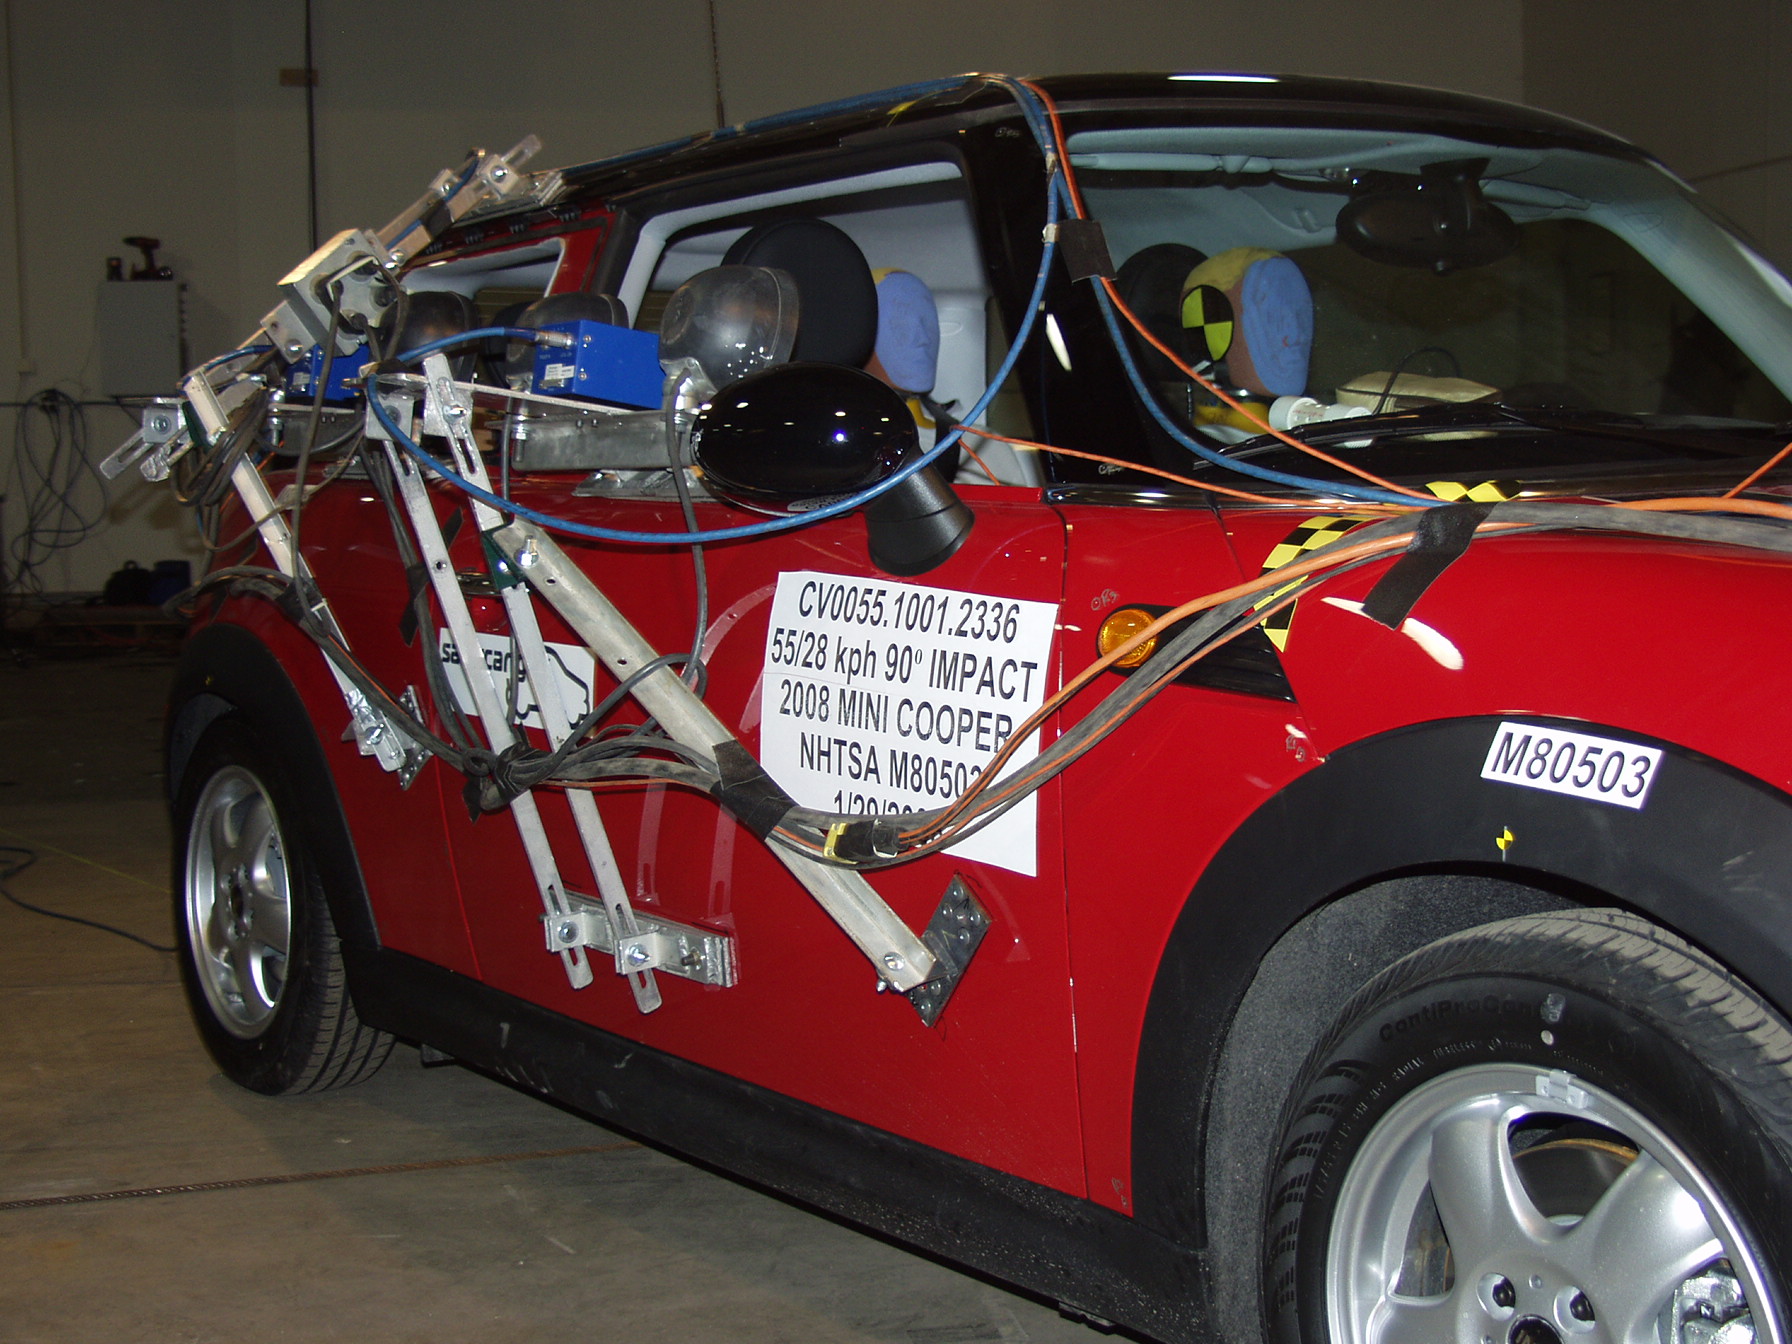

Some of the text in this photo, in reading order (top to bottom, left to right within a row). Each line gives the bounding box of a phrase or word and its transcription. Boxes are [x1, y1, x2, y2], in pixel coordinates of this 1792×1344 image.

[798, 581, 1020, 643] CV0055.1001.2336
[771, 627, 828, 670] 55/28
[835, 636, 878, 684] kph
[928, 648, 1038, 702] IMPACT
[779, 679, 1013, 754] 2008 MINI COOPER
[800, 732, 881, 784] NHTSA
[1491, 732, 1651, 798] M80503
